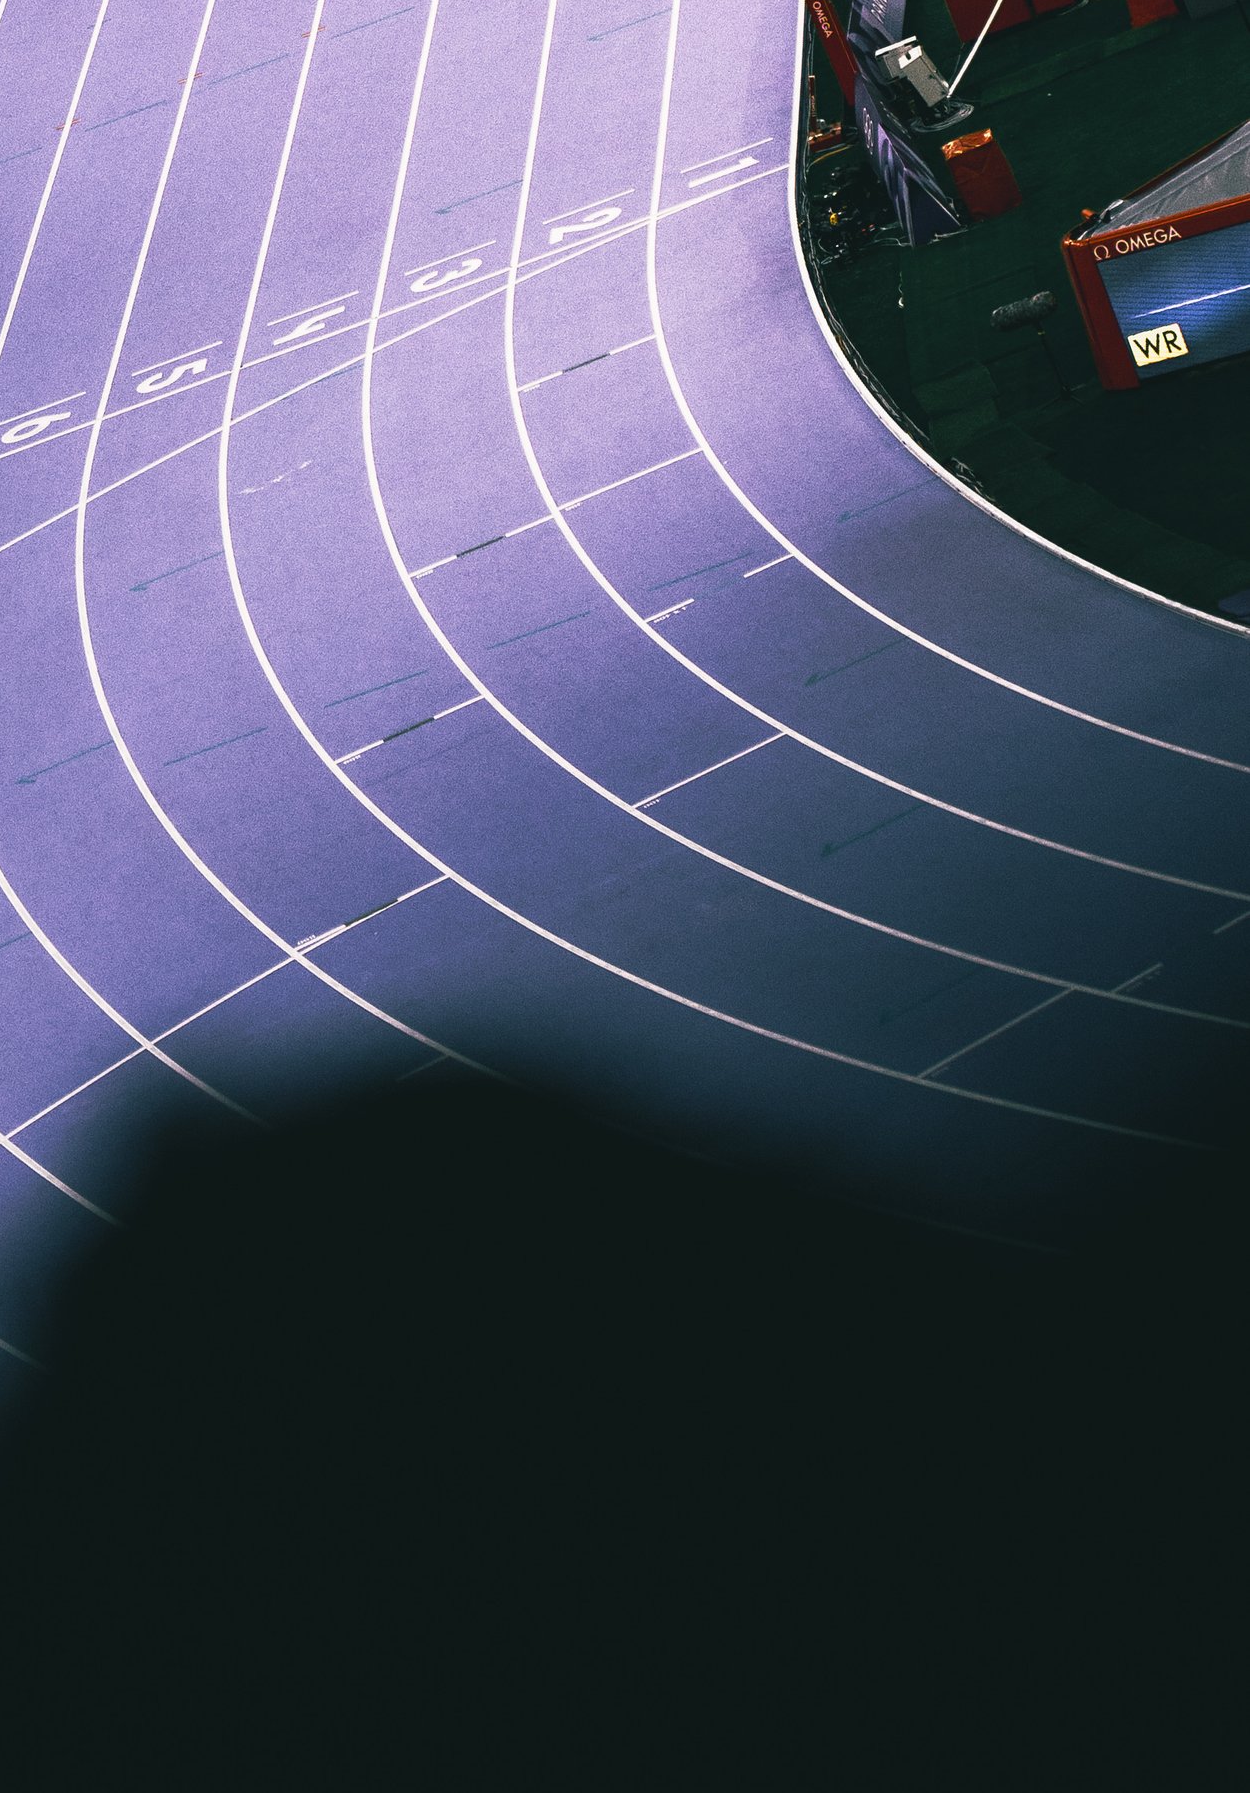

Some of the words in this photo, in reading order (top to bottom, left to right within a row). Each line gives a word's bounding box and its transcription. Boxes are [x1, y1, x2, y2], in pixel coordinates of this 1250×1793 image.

[812, 1, 835, 39] OMEGA
[687, 156, 761, 189] 1
[548, 207, 623, 246] 2
[1115, 225, 1182, 255] OMEGA
[408, 257, 484, 294] 3
[272, 305, 345, 347] 4
[1133, 329, 1183, 359] WR
[135, 358, 208, 394] 5
[1, 412, 72, 445] 6
